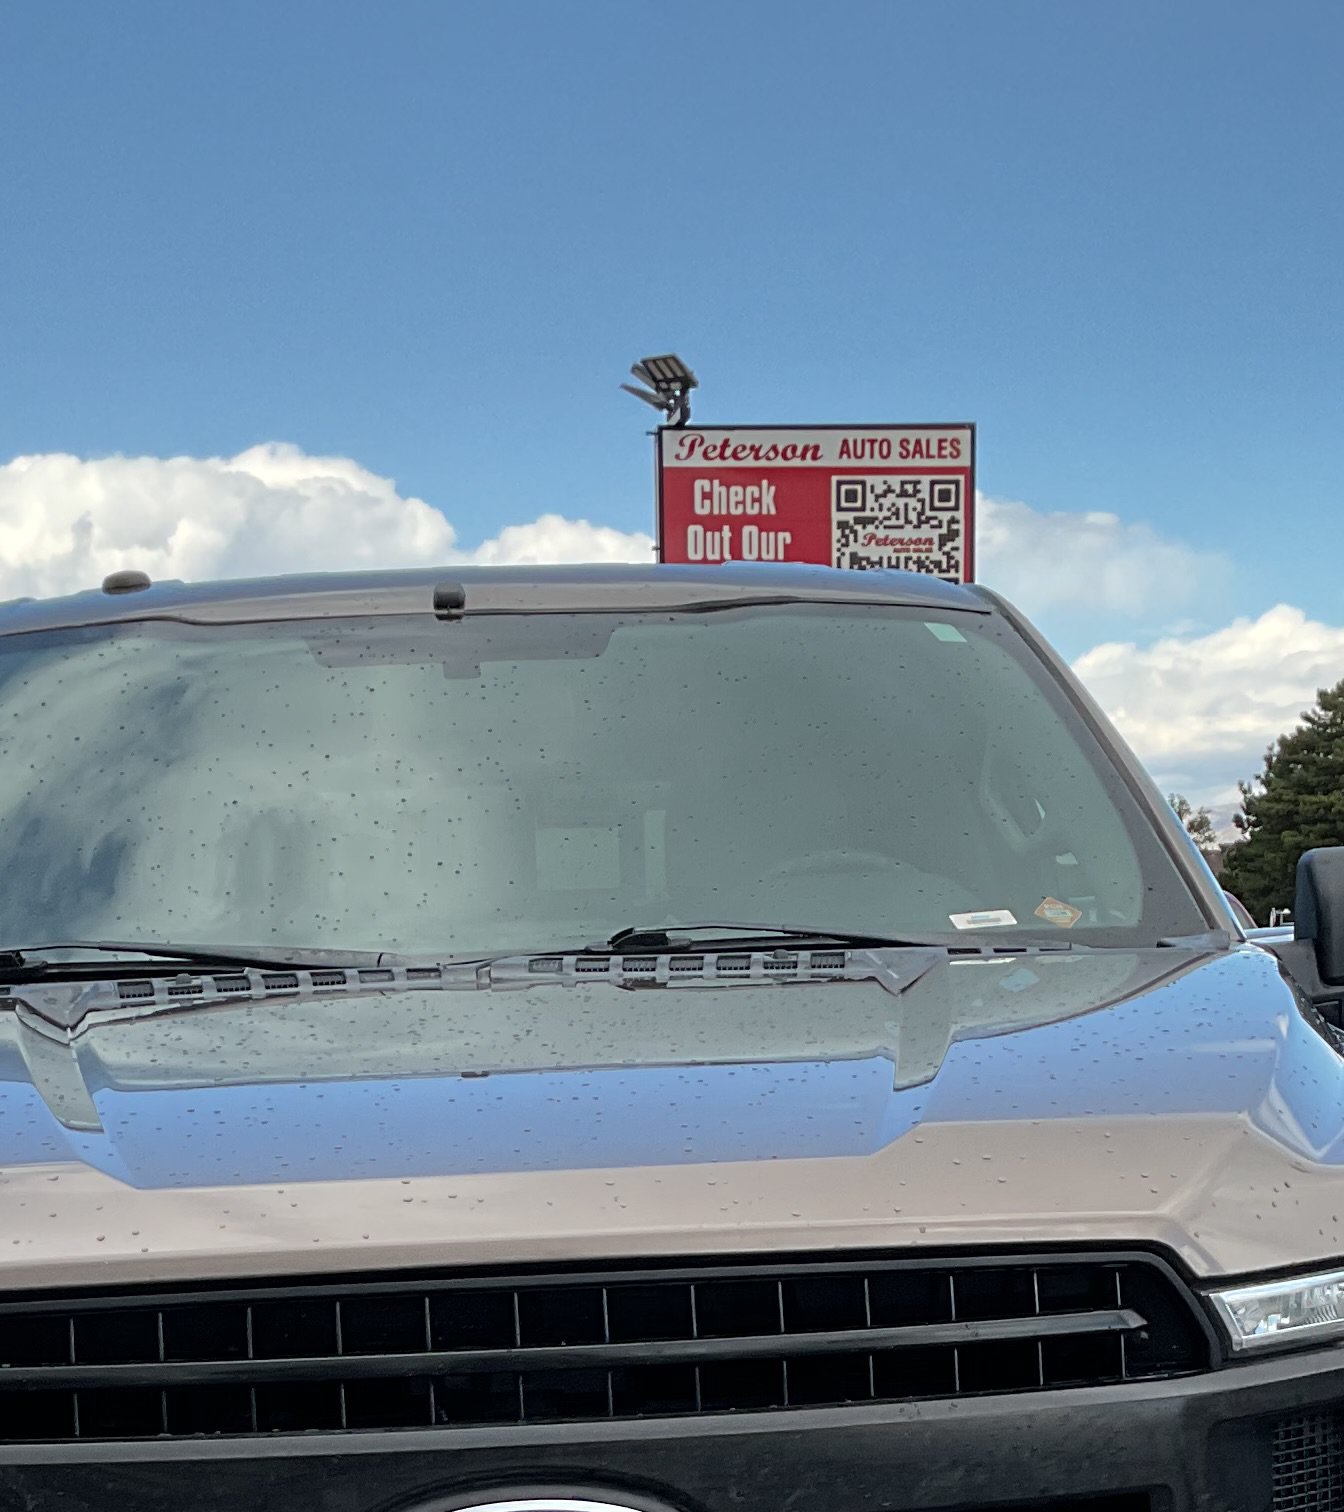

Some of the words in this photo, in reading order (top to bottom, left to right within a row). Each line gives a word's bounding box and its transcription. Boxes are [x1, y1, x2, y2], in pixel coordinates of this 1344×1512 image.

[674, 433, 823, 461] Peterson
[838, 438, 892, 460] AUTO
[899, 437, 962, 460] SALES
[693, 478, 777, 515] Check
[687, 524, 732, 560] Out
[742, 524, 792, 560] Our
[861, 532, 935, 547] Peterson
